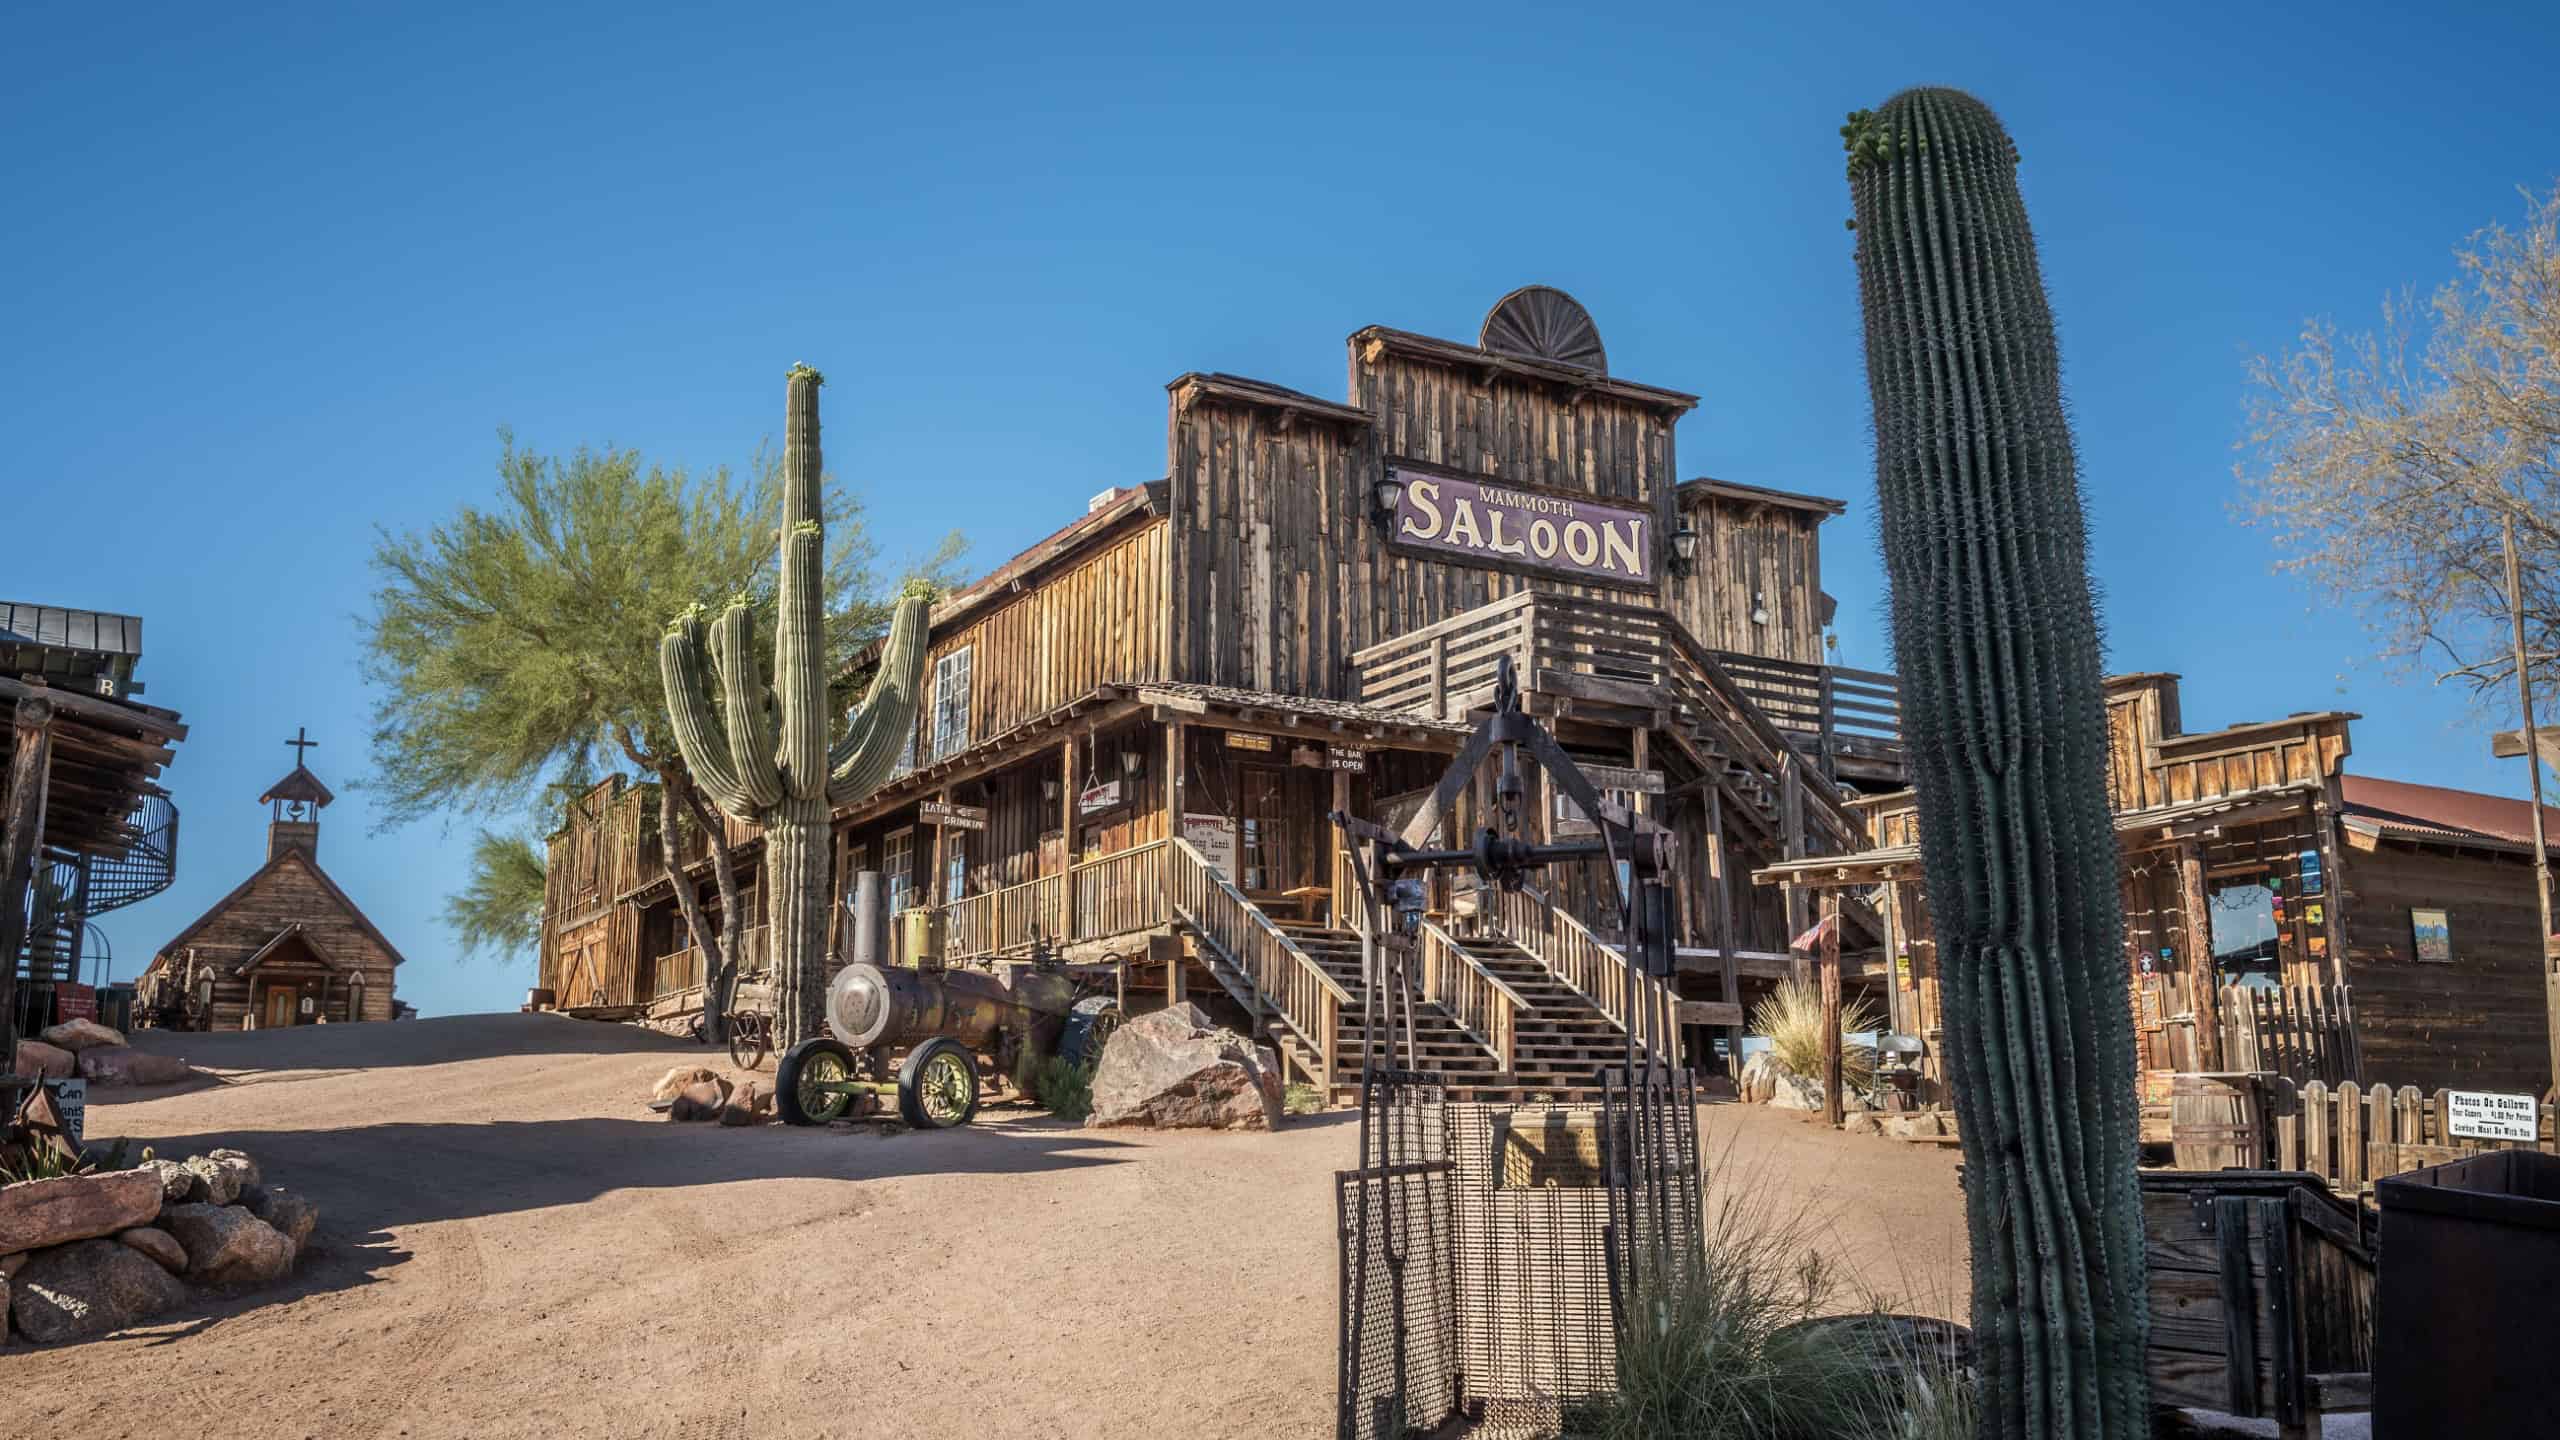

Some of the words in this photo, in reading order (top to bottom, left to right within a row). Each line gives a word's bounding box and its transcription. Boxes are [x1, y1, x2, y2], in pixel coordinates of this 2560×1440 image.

[1479, 486, 1574, 517] MAMMOTH
[1401, 479, 1642, 576] SALOON
[1330, 748, 1345, 757] THE
[1347, 750, 1362, 759] BAR
[1332, 759, 1340, 768] IS
[1342, 760, 1363, 770] OPEN
[2455, 1095, 2480, 1107] Photos
[2484, 1097, 2494, 1108] On
[2497, 1098, 2529, 1110] Gallows
[2477, 1125, 2492, 1135] Must
[2504, 1127, 2517, 1136] With
